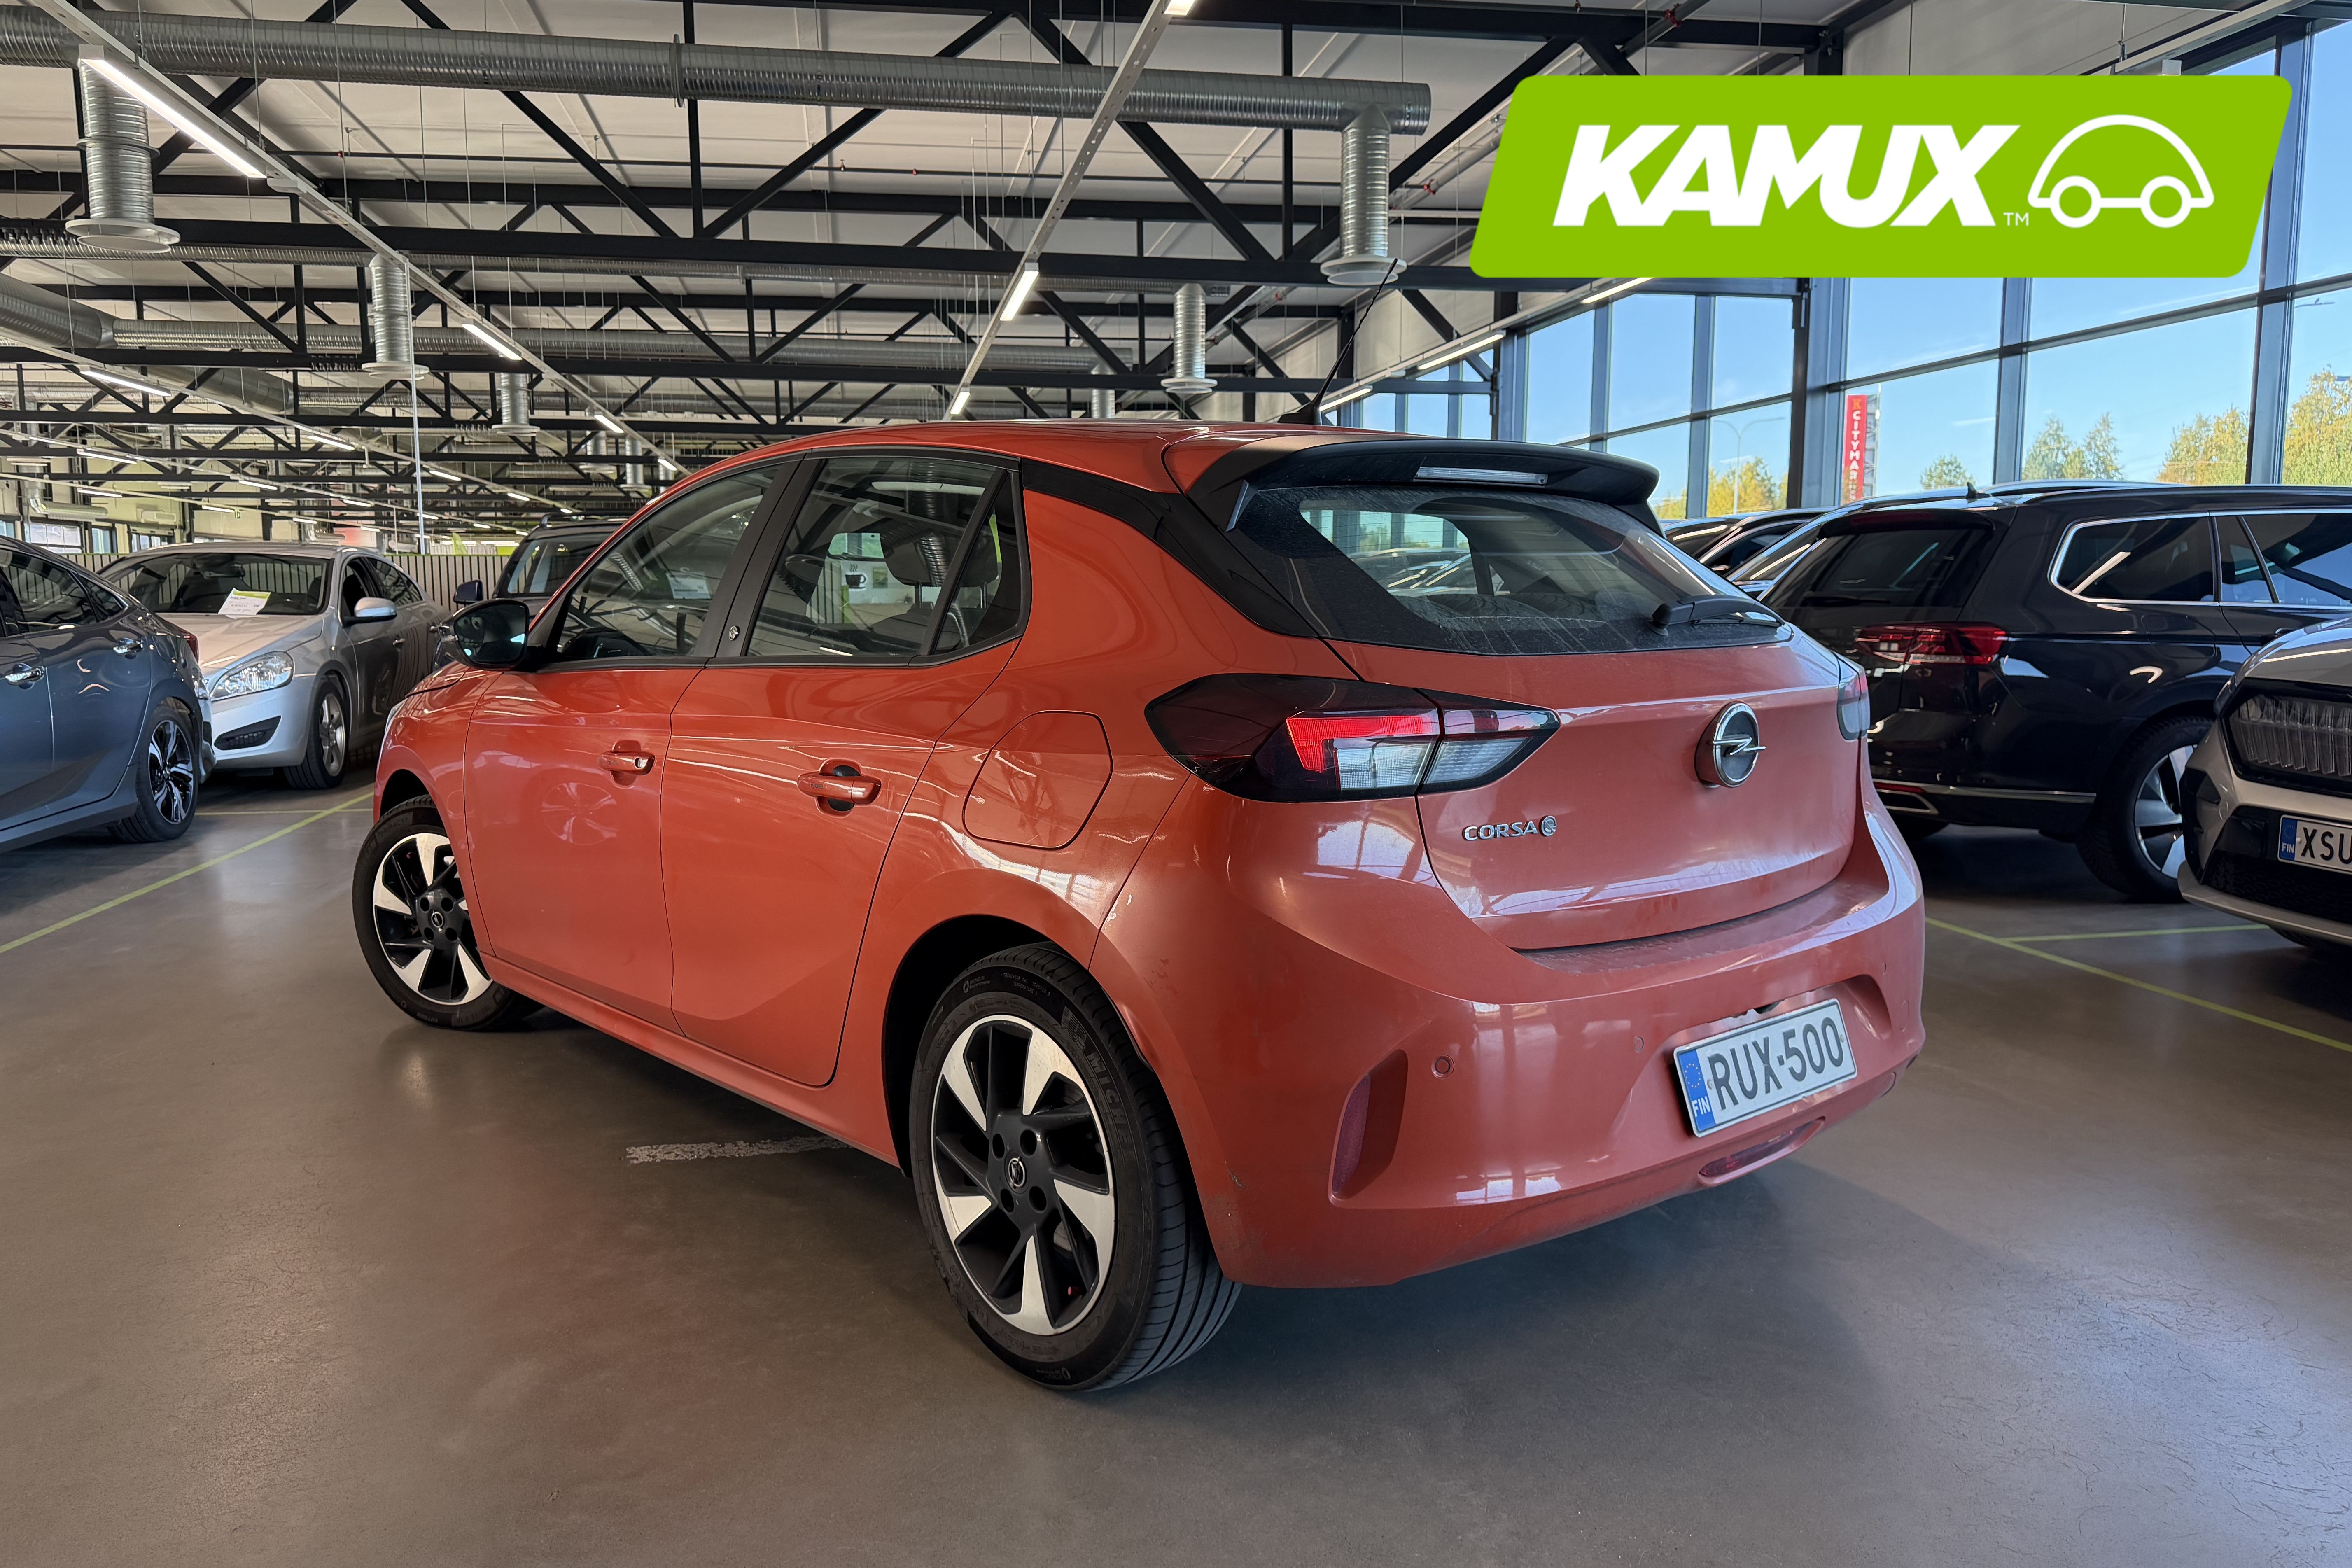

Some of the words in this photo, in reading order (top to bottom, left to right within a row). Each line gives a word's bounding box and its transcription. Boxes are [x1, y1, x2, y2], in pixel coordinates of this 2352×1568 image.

[1463, 821, 1538, 840] CORSA
[2282, 842, 2294, 854] FIN
[2301, 827, 2352, 864] XSU
[1708, 1017, 1844, 1111] RUX-500
[1692, 1096, 1711, 1118] FIN
